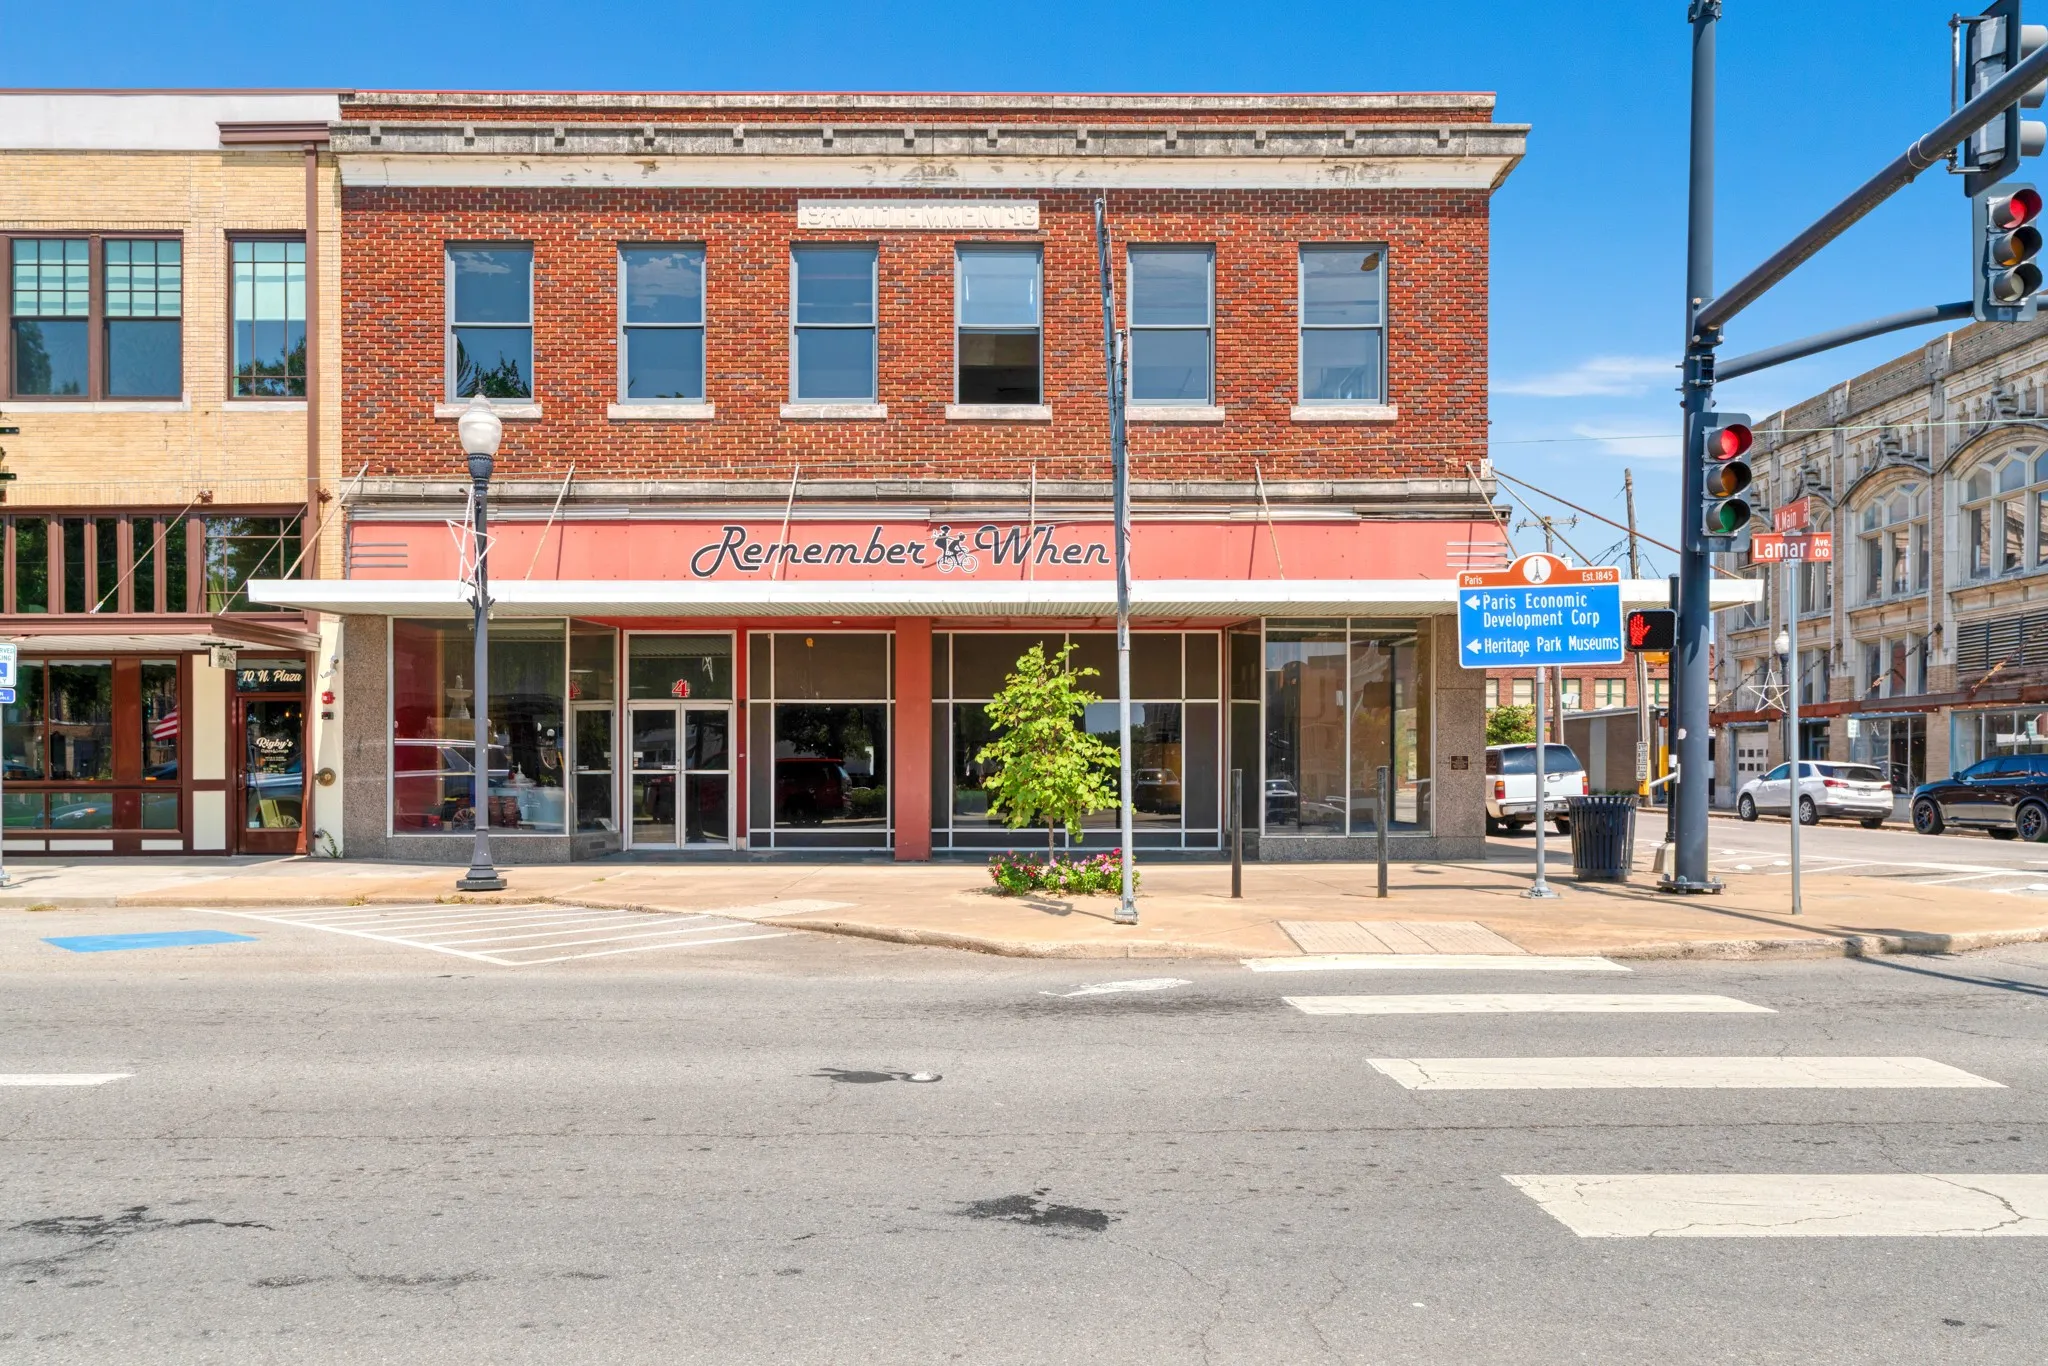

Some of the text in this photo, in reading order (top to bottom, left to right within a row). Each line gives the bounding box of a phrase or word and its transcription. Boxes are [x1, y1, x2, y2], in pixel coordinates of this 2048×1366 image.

[690, 525, 1111, 578] Remember When
[1754, 538, 1831, 559] Lamar Ave.
[1464, 575, 1483, 585] Paris
[1483, 592, 1588, 610] Paris Economic
[1484, 609, 1600, 629] Development Corp
[1484, 635, 1619, 657] Heritage Park Museums
[242, 669, 255, 682] 10
[273, 669, 303, 682] Plaza
[672, 679, 690, 698] 4
[256, 737, 294, 749] Rigby's
